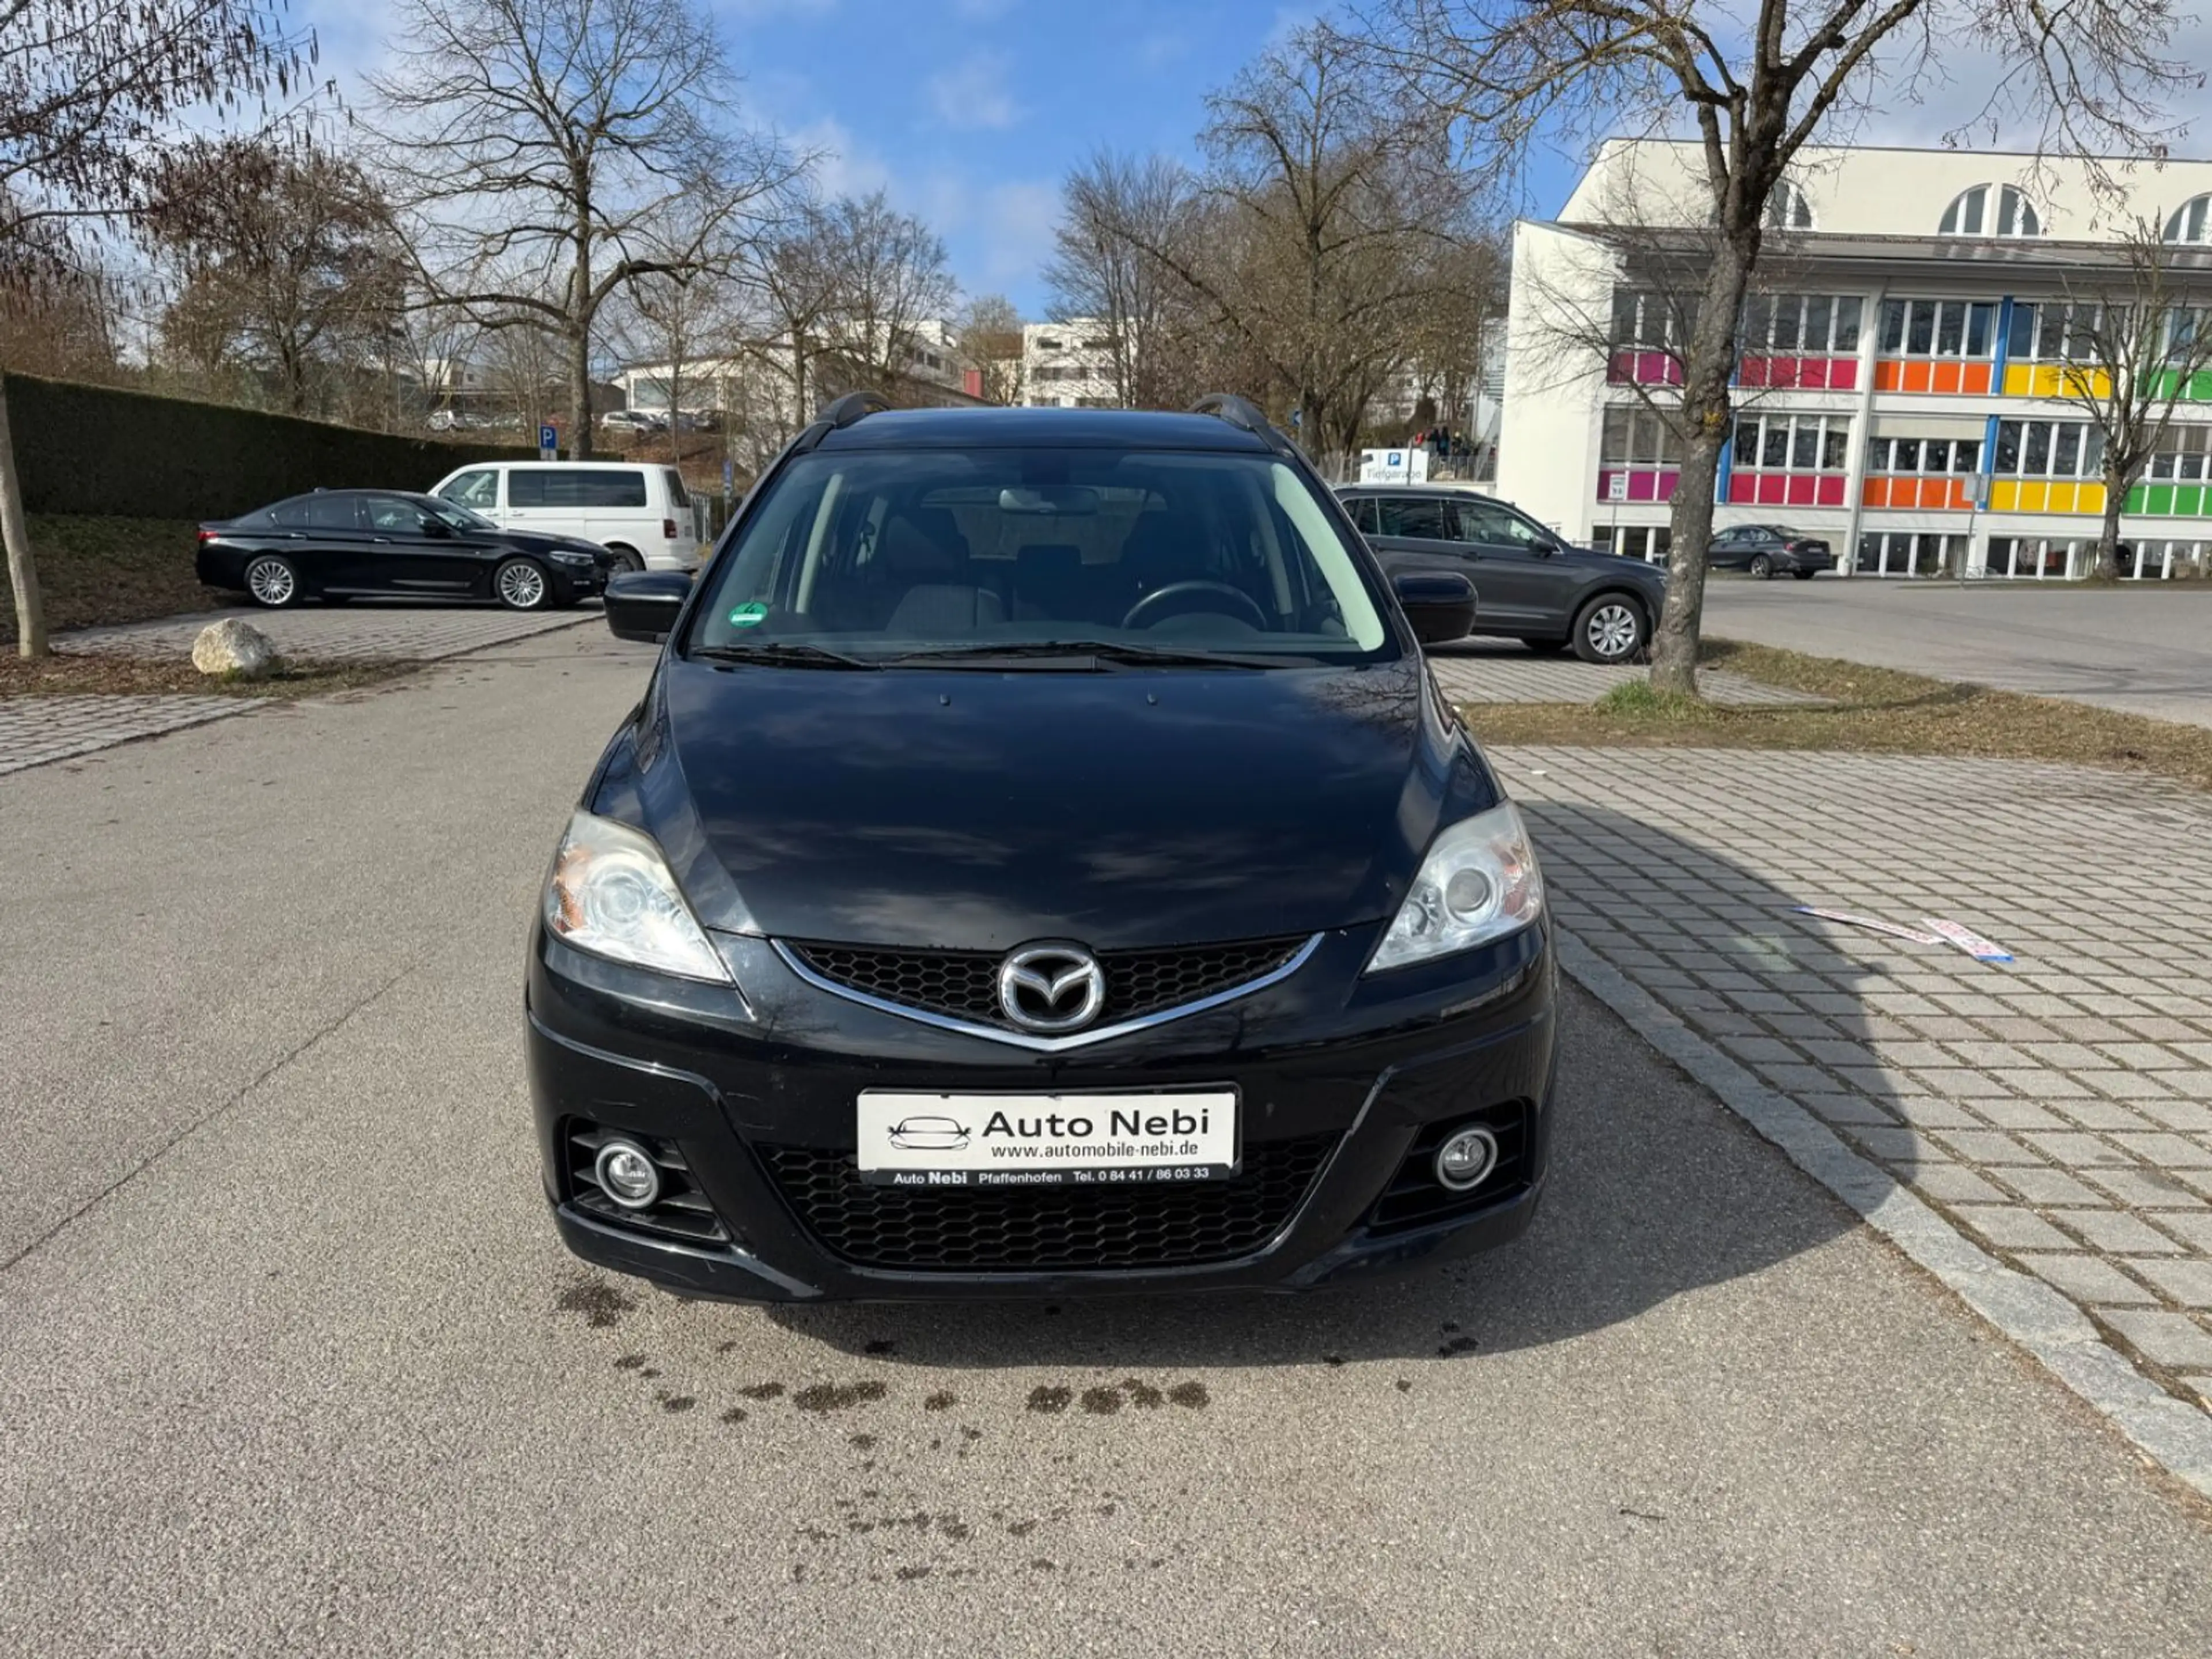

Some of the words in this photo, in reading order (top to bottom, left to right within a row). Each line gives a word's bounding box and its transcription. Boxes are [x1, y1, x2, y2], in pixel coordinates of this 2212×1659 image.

[543, 429, 553, 445] P
[982, 1111, 1093, 1137] Auto
[1111, 1108, 1209, 1136] Nebi
[991, 1139, 1198, 1158] www.automobile-nebi.de
[893, 1172, 925, 1184] Auto
[928, 1171, 967, 1184] Nebi
[979, 1172, 1062, 1184] Pfaffenhofen
[1073, 1171, 1094, 1182] Tel.
[1098, 1171, 1107, 1181] 0
[1109, 1170, 1125, 1181] 84
[1128, 1169, 1143, 1181] 41
[1147, 1169, 1153, 1180] /
[1156, 1168, 1172, 1180] 86
[1175, 1168, 1190, 1179] 03
[1194, 1166, 1209, 1179] 33
